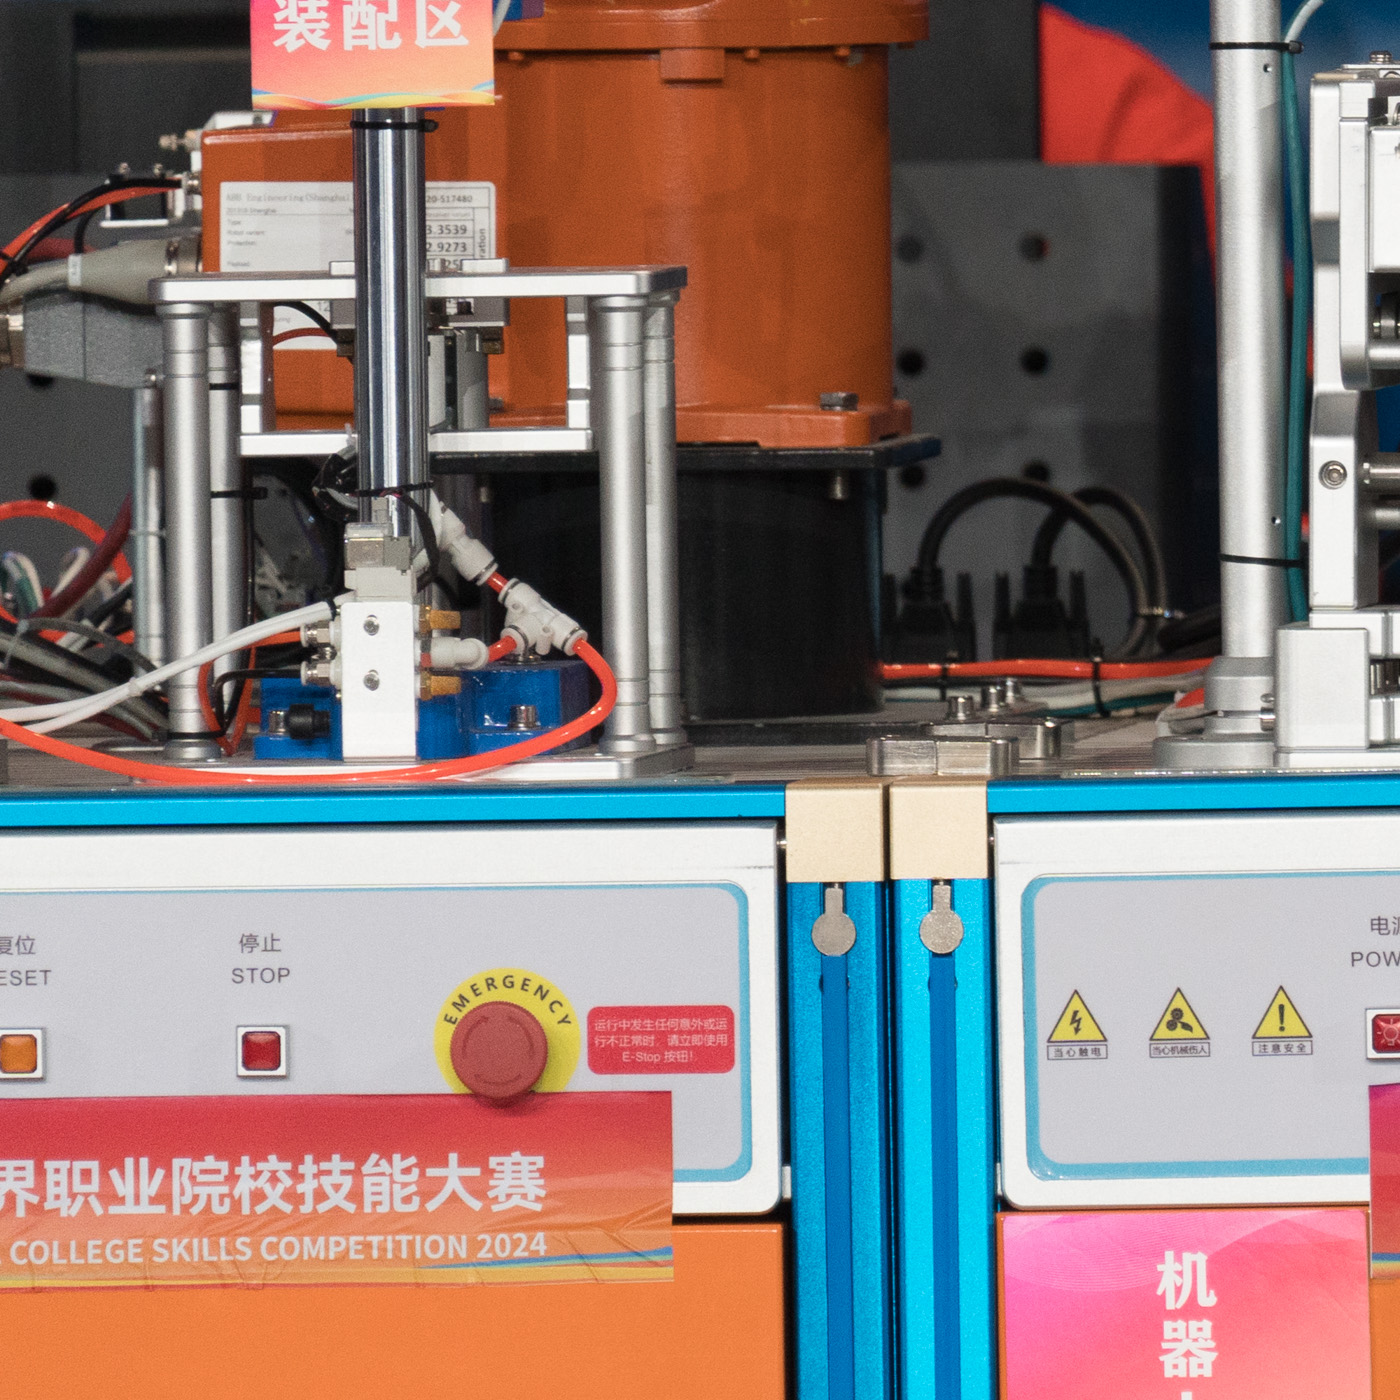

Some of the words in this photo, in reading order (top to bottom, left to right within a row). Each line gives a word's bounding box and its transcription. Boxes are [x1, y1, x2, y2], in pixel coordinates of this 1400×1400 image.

[238, 933, 282, 954] 停止
[231, 967, 291, 985] STOP
[443, 974, 572, 1026] EMERGENCY
[594, 1018, 728, 1032] 运行中发生任何意外或运
[1053, 1046, 1102, 1059] 当心触电
[1151, 1045, 1208, 1056] 当心机械伤人
[1257, 1042, 1307, 1054] 注意安全
[621, 1052, 661, 1064] E-Stop
[0, 1151, 547, 1218] 界职业院校技能大赛
[10, 1238, 144, 1266] COLLEGE
[152, 1236, 252, 1263] SKILLS
[260, 1234, 468, 1261] COMPETITION
[476, 1231, 547, 1259] 2024
[1156, 1250, 1219, 1400] 机器
